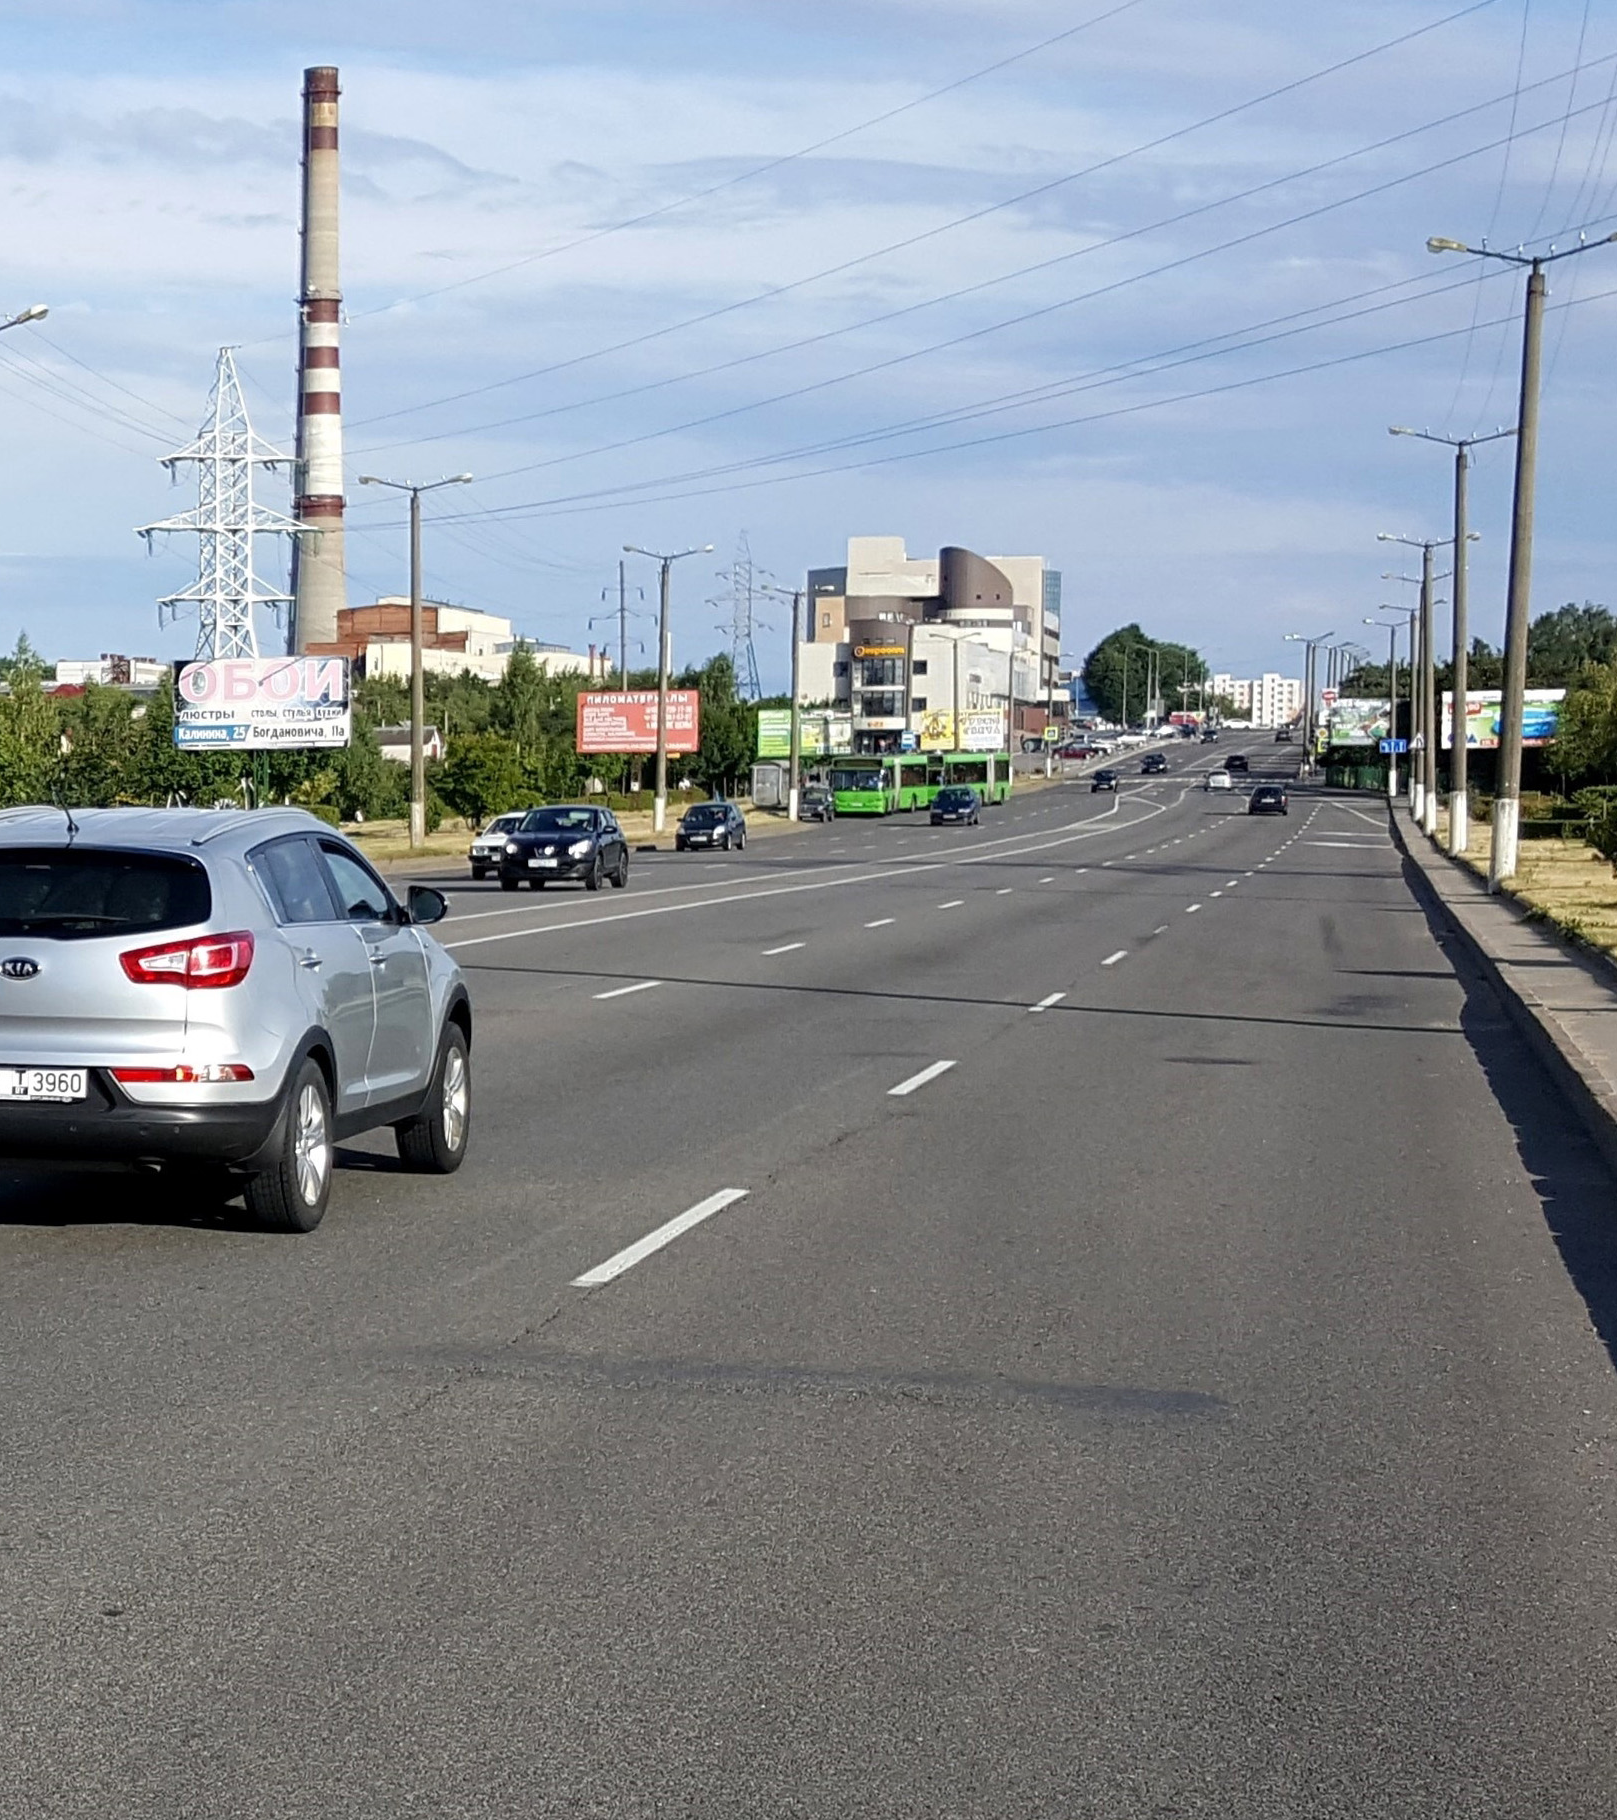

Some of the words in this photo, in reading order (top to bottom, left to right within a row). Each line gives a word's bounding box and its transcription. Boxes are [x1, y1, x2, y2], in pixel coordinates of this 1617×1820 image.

[179, 660, 343, 703] ОБОИ
[182, 710, 234, 721] люстры
[283, 708, 311, 719] стулья
[178, 727, 230, 742] Калинина,
[233, 726, 246, 740] 25
[253, 726, 327, 740] Богдановича,
[4, 962, 33, 976] KIA
[33, 1072, 82, 1093] 3960
